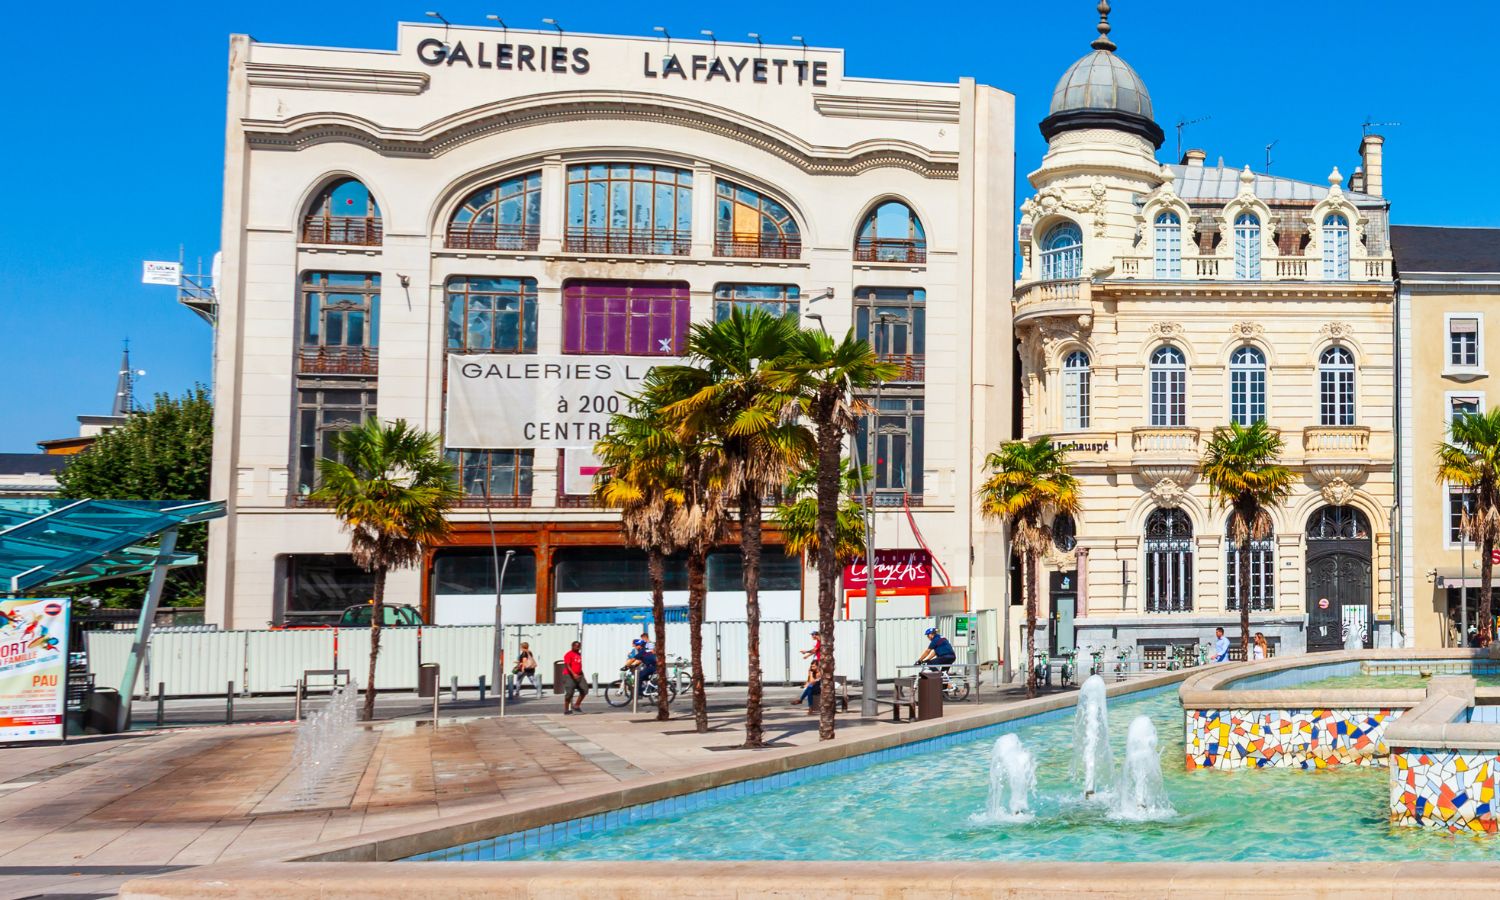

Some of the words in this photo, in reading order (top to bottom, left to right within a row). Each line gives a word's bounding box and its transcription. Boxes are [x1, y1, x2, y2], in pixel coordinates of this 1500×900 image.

[416, 37, 590, 75] GALERIES
[643, 51, 828, 87] LAFAYETTE
[461, 363, 612, 380] GALERIES
[557, 396, 568, 413] à
[578, 395, 619, 413] 200
[32, 674, 58, 687] PAU
